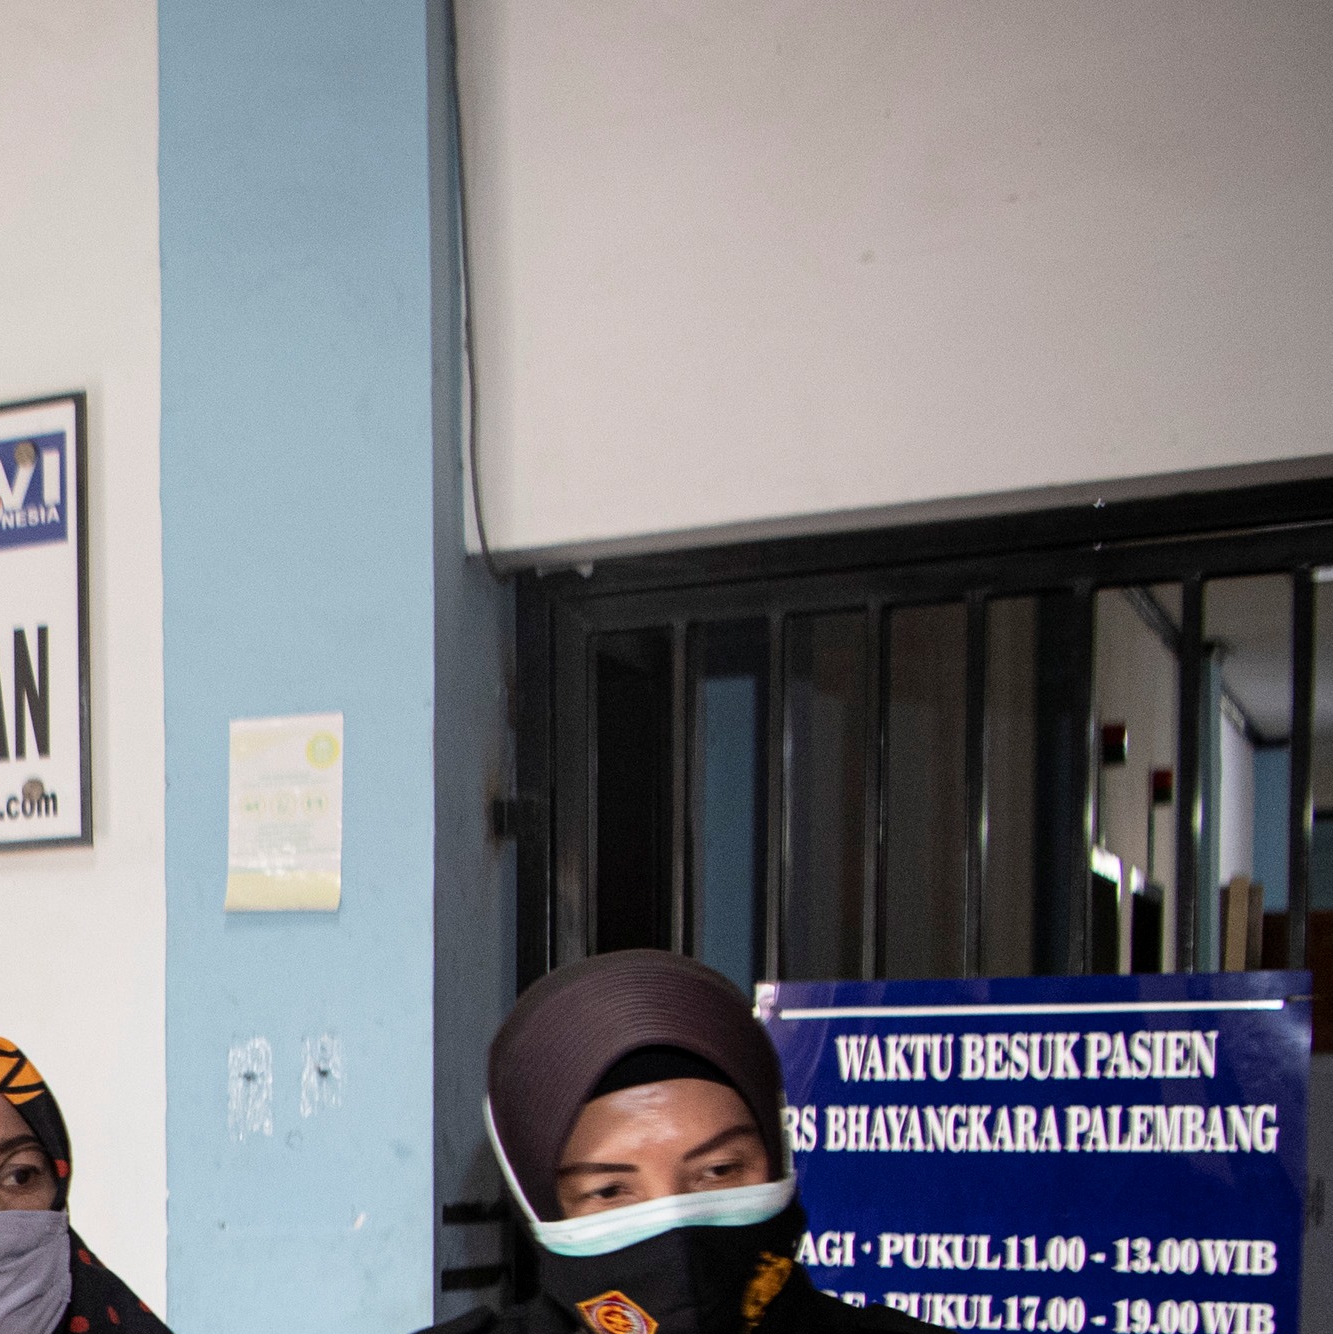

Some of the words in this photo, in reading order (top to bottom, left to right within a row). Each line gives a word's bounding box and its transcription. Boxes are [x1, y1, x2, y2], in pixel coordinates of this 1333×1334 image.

[835, 1032, 954, 1082] WAKTU
[958, 1032, 1081, 1081] BESUK
[1083, 1030, 1219, 1080] PASIEN
[781, 1104, 817, 1153] RS
[824, 1104, 1062, 1153] BHAYANGKARA
[1064, 1104, 1279, 1154] PALEMBANG
[793, 1230, 856, 1268] AGI
[877, 1232, 1001, 1271] PUKUL
[1002, 1234, 1086, 1273] 11.00
[1112, 1236, 1200, 1275] 13.00
[1199, 1239, 1278, 1276] WIB
[883, 1292, 1002, 1331] PUKUL
[1002, 1295, 1086, 1333] 17.00
